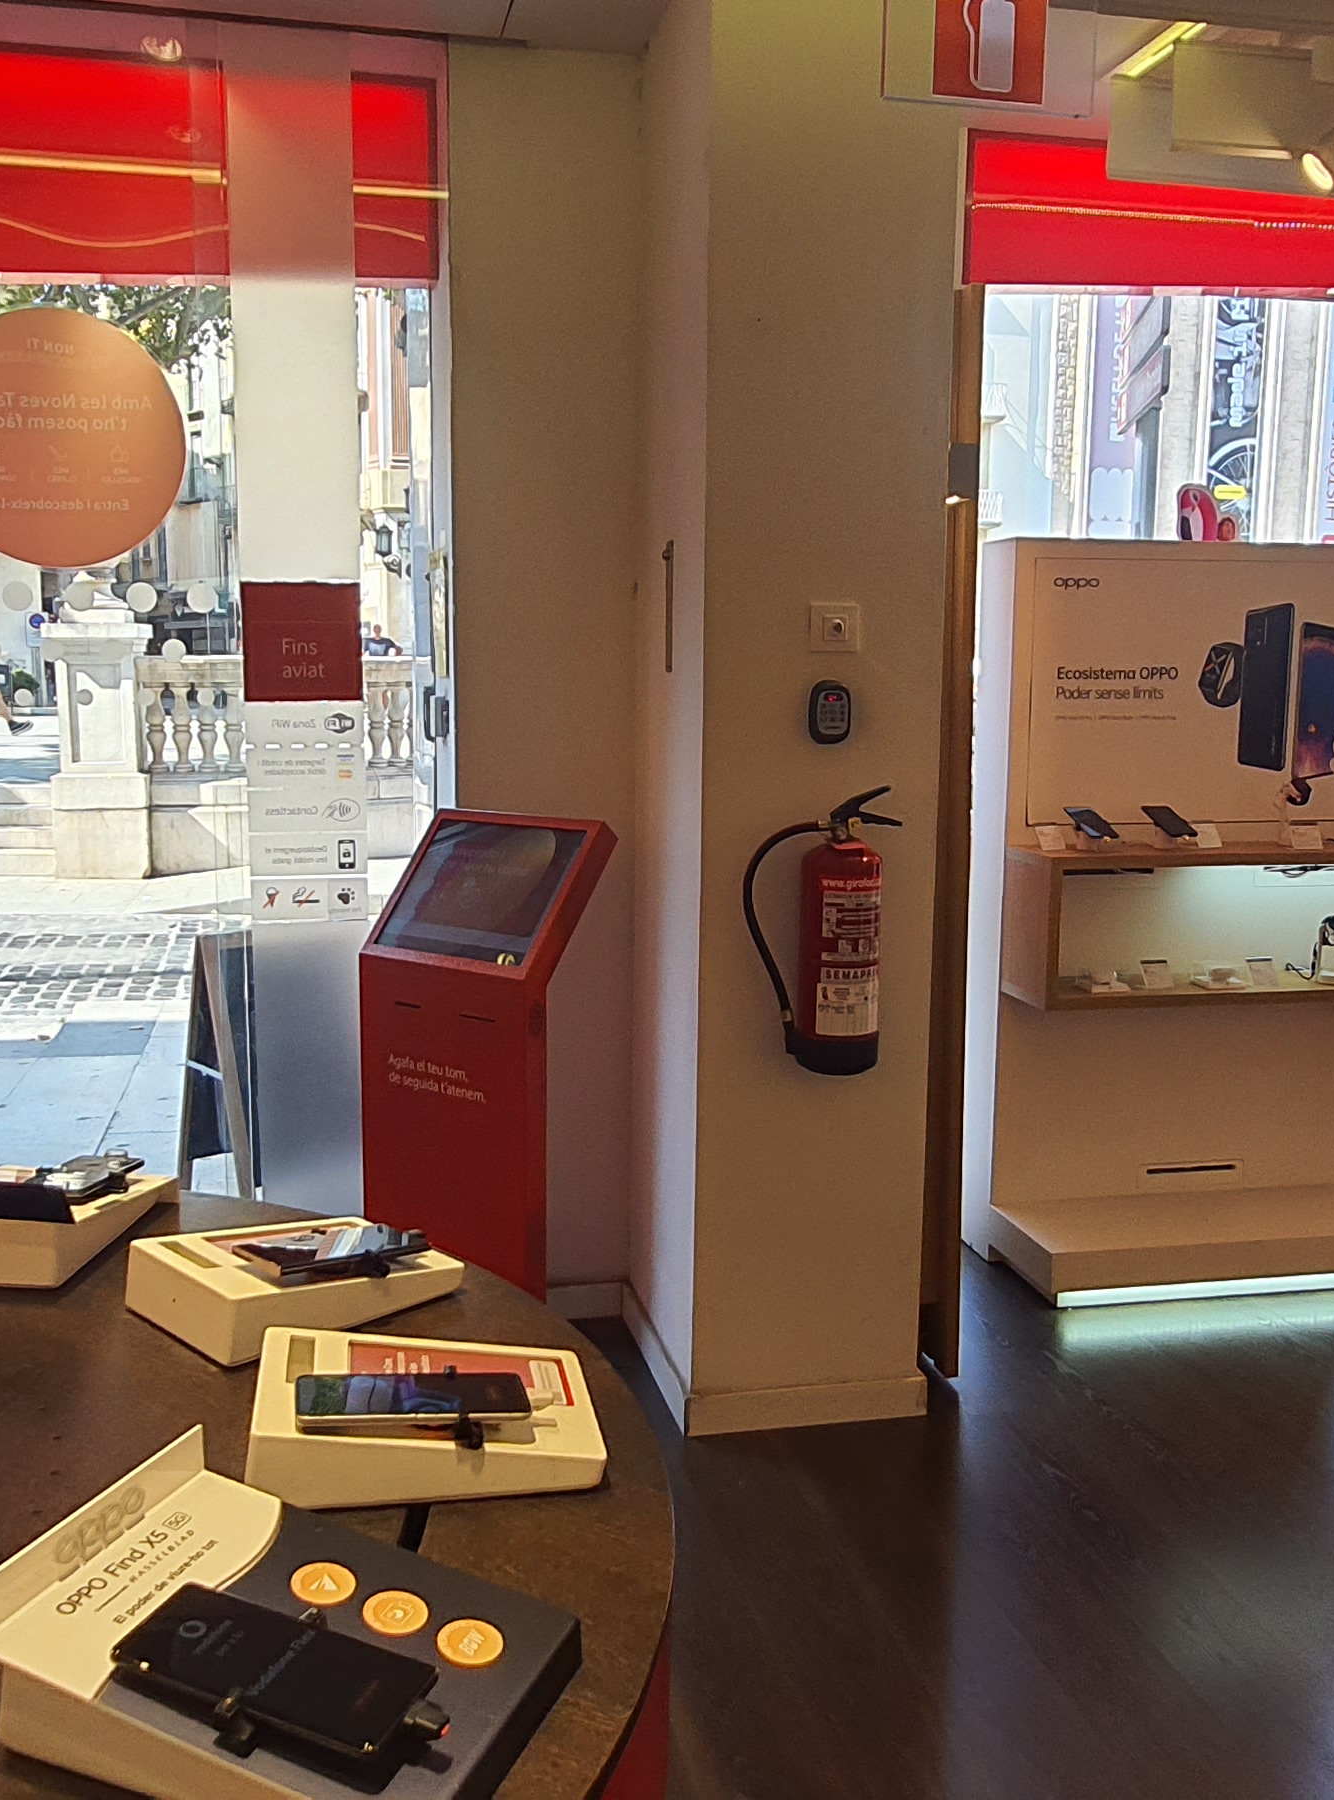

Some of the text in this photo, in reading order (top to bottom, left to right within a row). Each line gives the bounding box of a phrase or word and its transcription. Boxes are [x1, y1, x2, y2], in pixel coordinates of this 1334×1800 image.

[1054, 576, 1099, 590] oppo
[282, 637, 318, 655] Fins
[282, 662, 326, 678] aviat
[1057, 666, 1179, 681] Ecosistema OPPO
[1056, 686, 1093, 701] Poder
[1094, 687, 1131, 700] sense
[388, 1053, 415, 1070] Agafa
[417, 1060, 426, 1072] el
[427, 1062, 443, 1076] teu
[389, 1071, 401, 1084] de
[403, 1075, 439, 1092] seguida
[128, 1530, 195, 1584] HASSELBLAD
[56, 1577, 108, 1615] OPPO
[103, 1548, 147, 1578] Find
[139, 1530, 169, 1549] X5
[113, 1614, 128, 1625] El
[126, 1591, 155, 1617] poder
[154, 1580, 168, 1592] de
